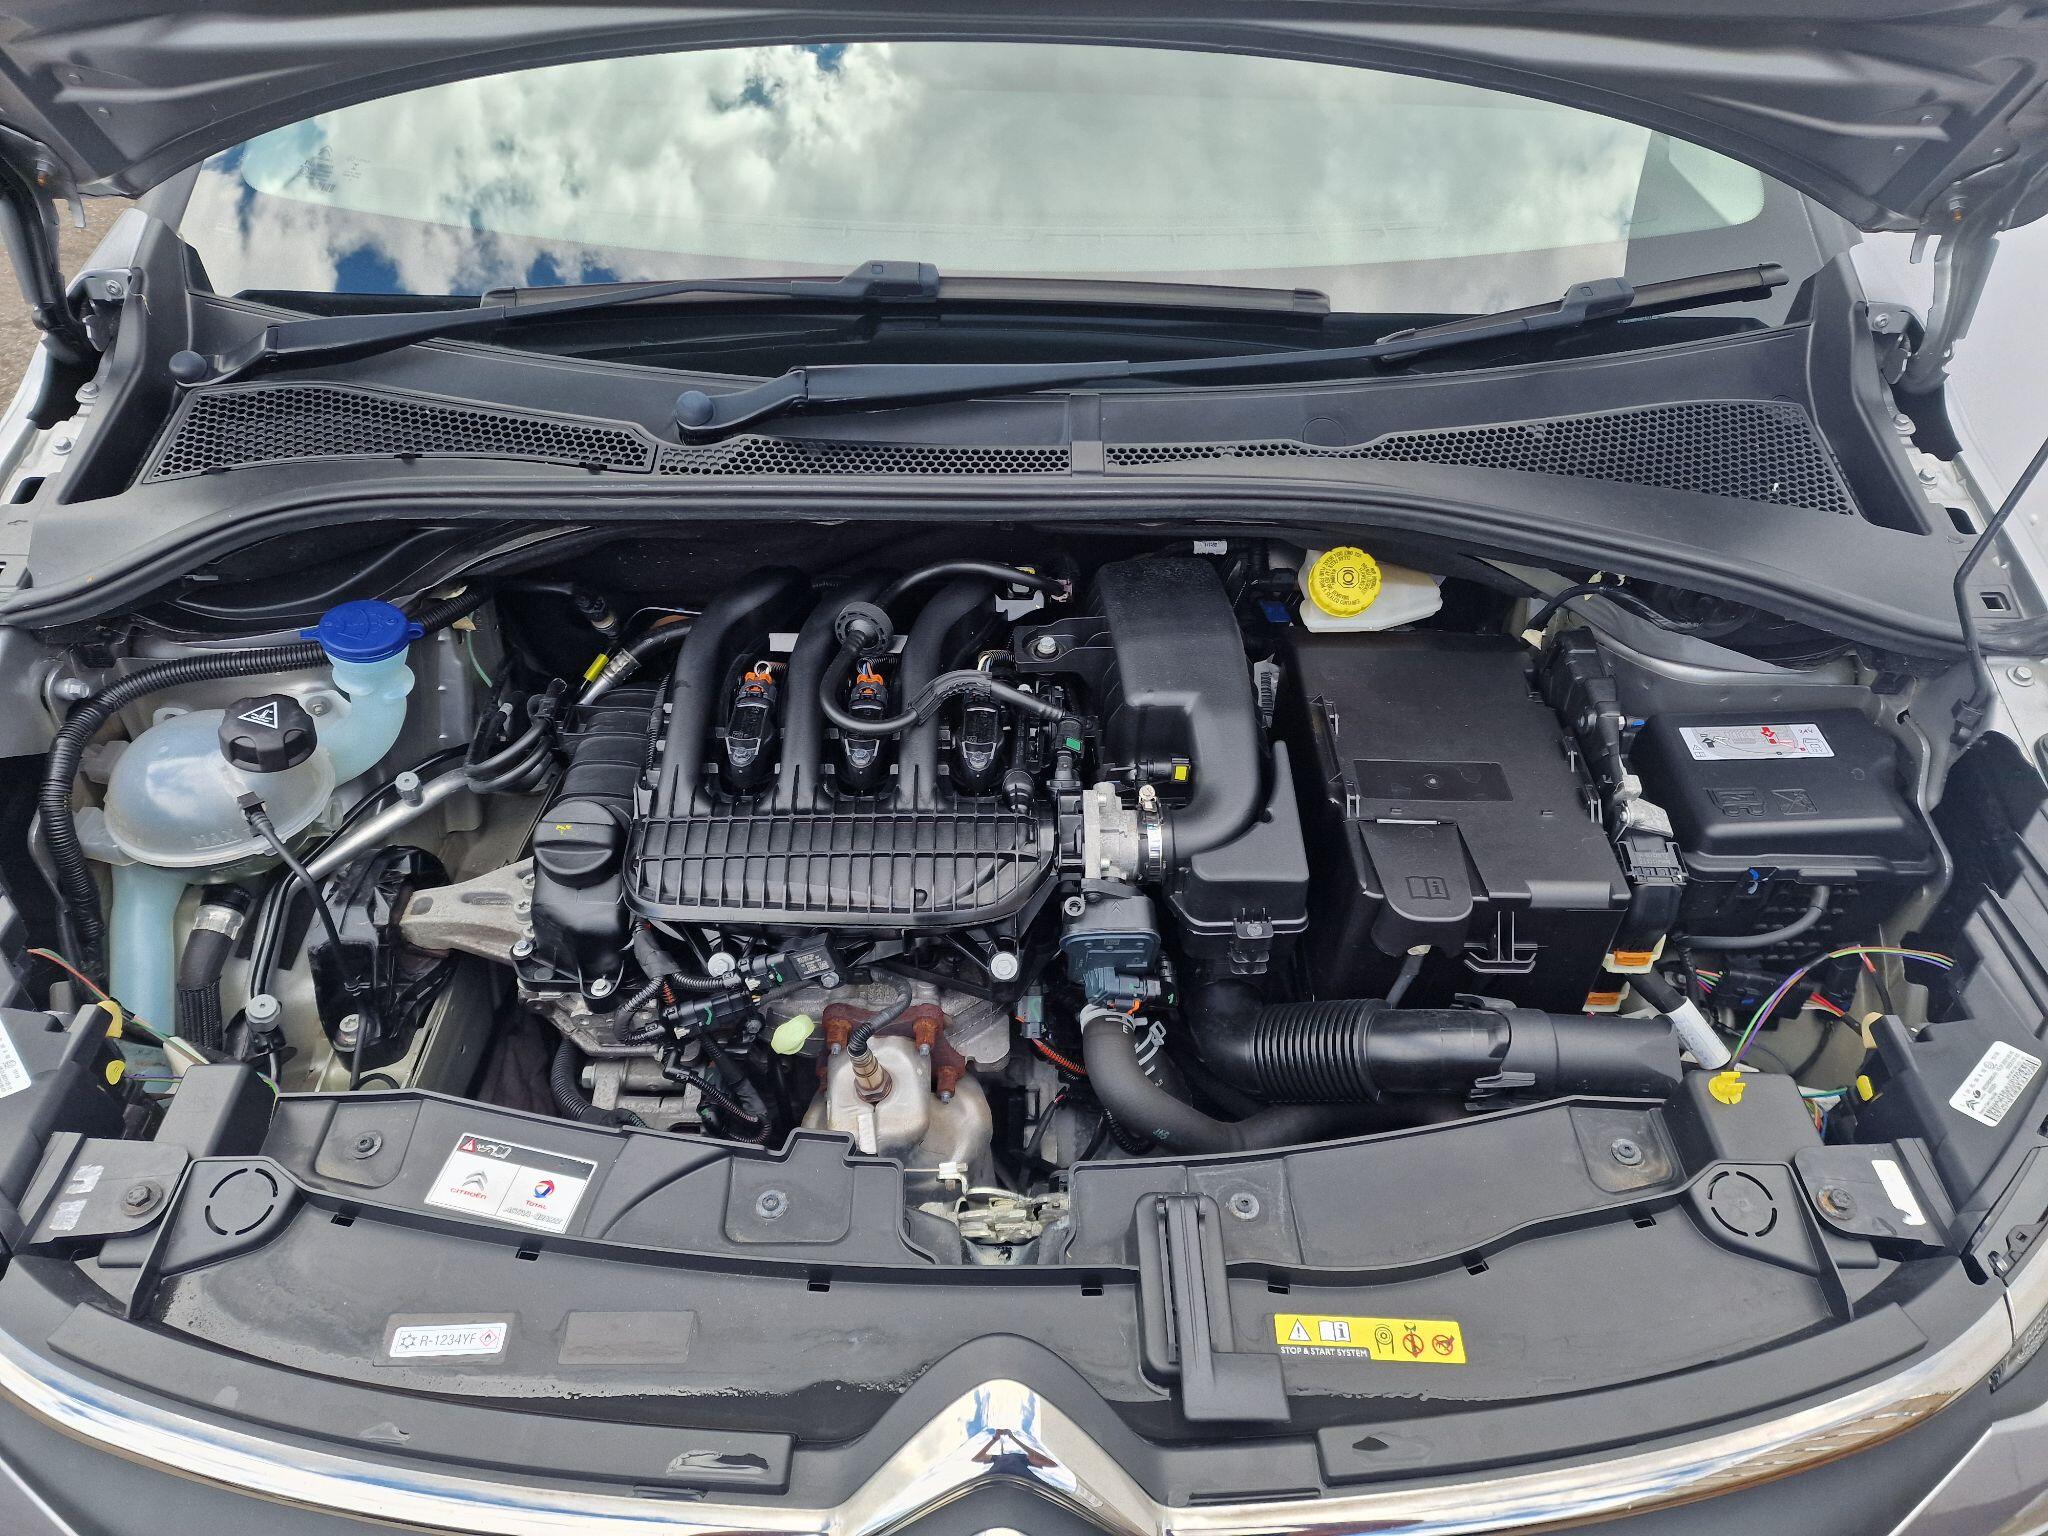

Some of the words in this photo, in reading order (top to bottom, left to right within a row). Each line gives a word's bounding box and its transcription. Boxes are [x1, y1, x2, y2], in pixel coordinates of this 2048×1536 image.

[449, 1186, 487, 1200] CITROËN
[525, 1199, 548, 1210] TOTAL
[419, 1332, 477, 1346] R-1234YF
[1280, 1346, 1301, 1355] STOP
[1303, 1347, 1310, 1355] &
[1310, 1347, 1335, 1356] START
[1337, 1349, 1368, 1357] SYSTEM
